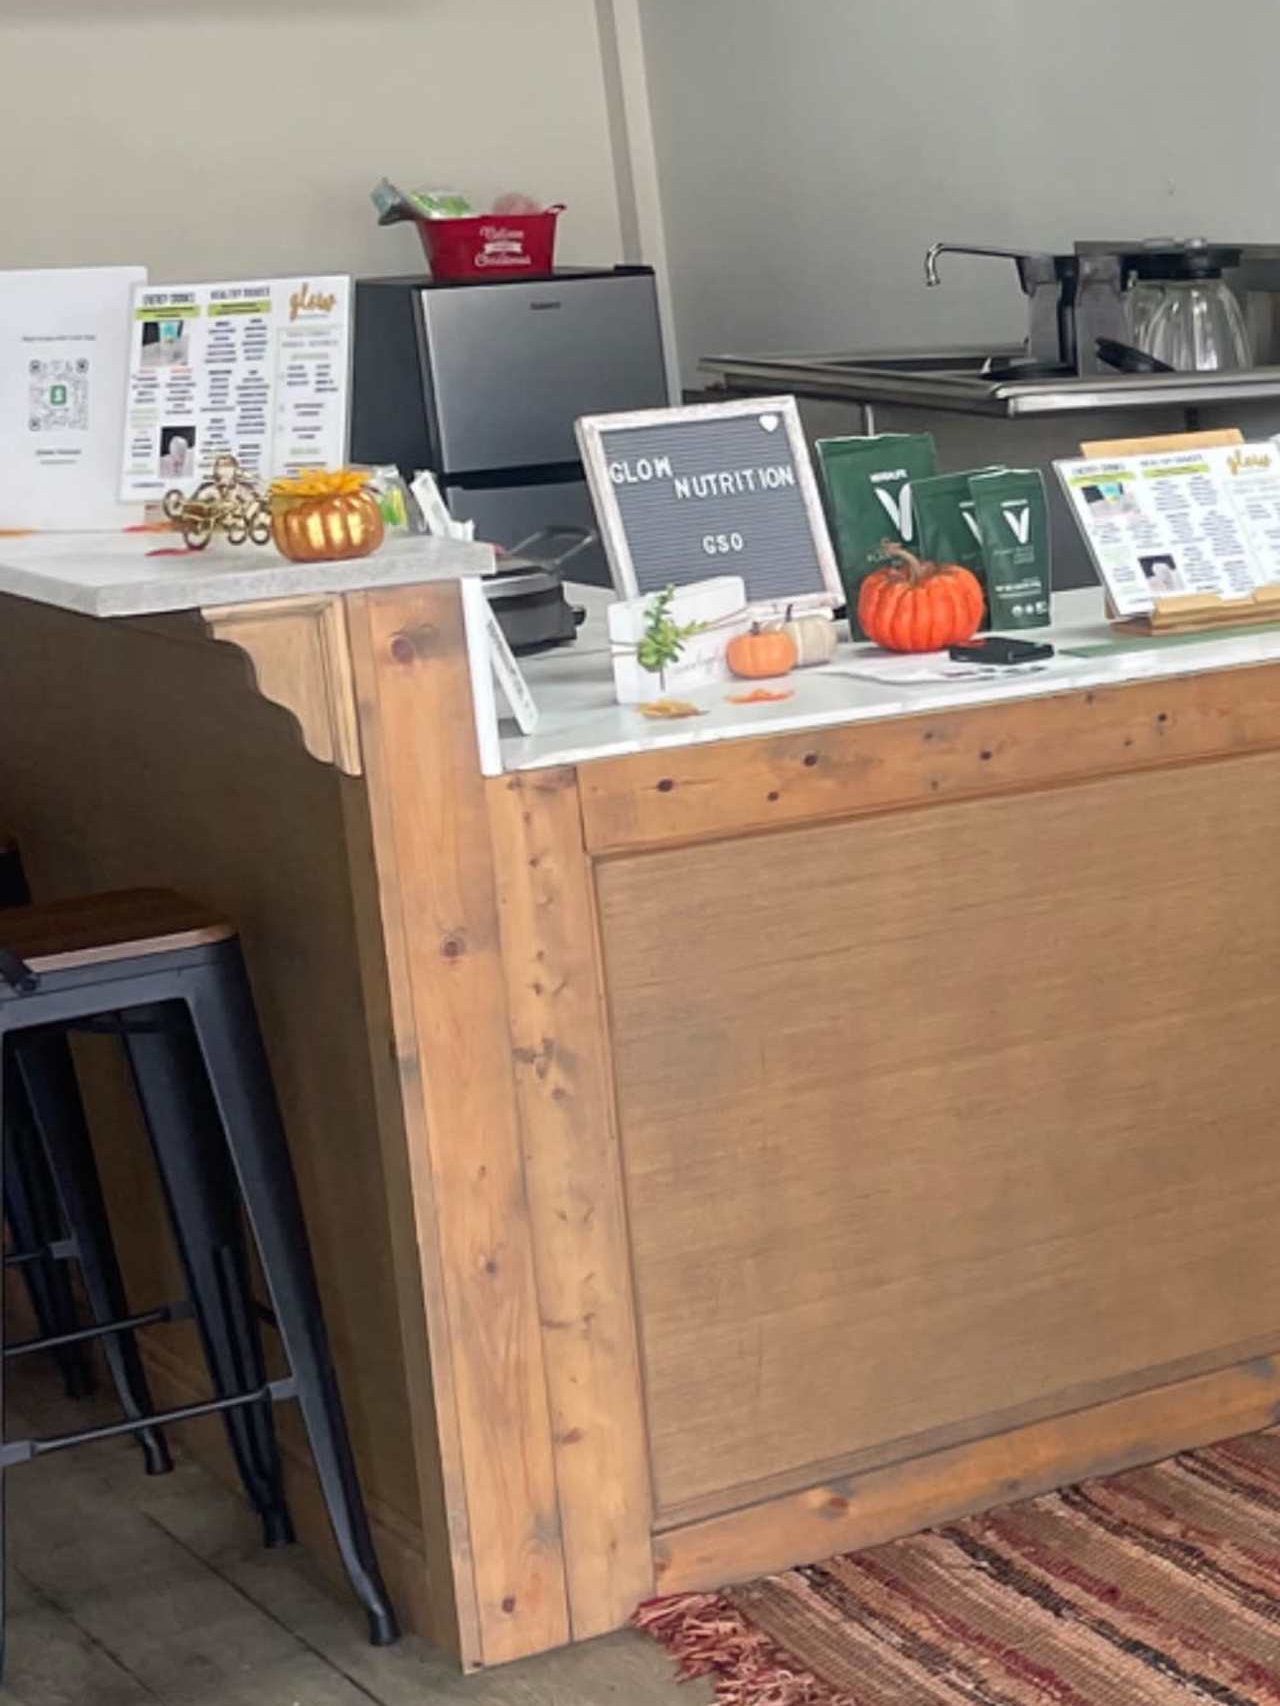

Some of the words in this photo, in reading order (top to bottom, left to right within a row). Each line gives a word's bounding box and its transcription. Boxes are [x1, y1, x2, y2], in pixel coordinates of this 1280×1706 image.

[289, 283, 336, 322] glow
[609, 456, 673, 483] GLOW
[674, 465, 796, 499] NUTRITION
[702, 533, 743, 554] GSO
